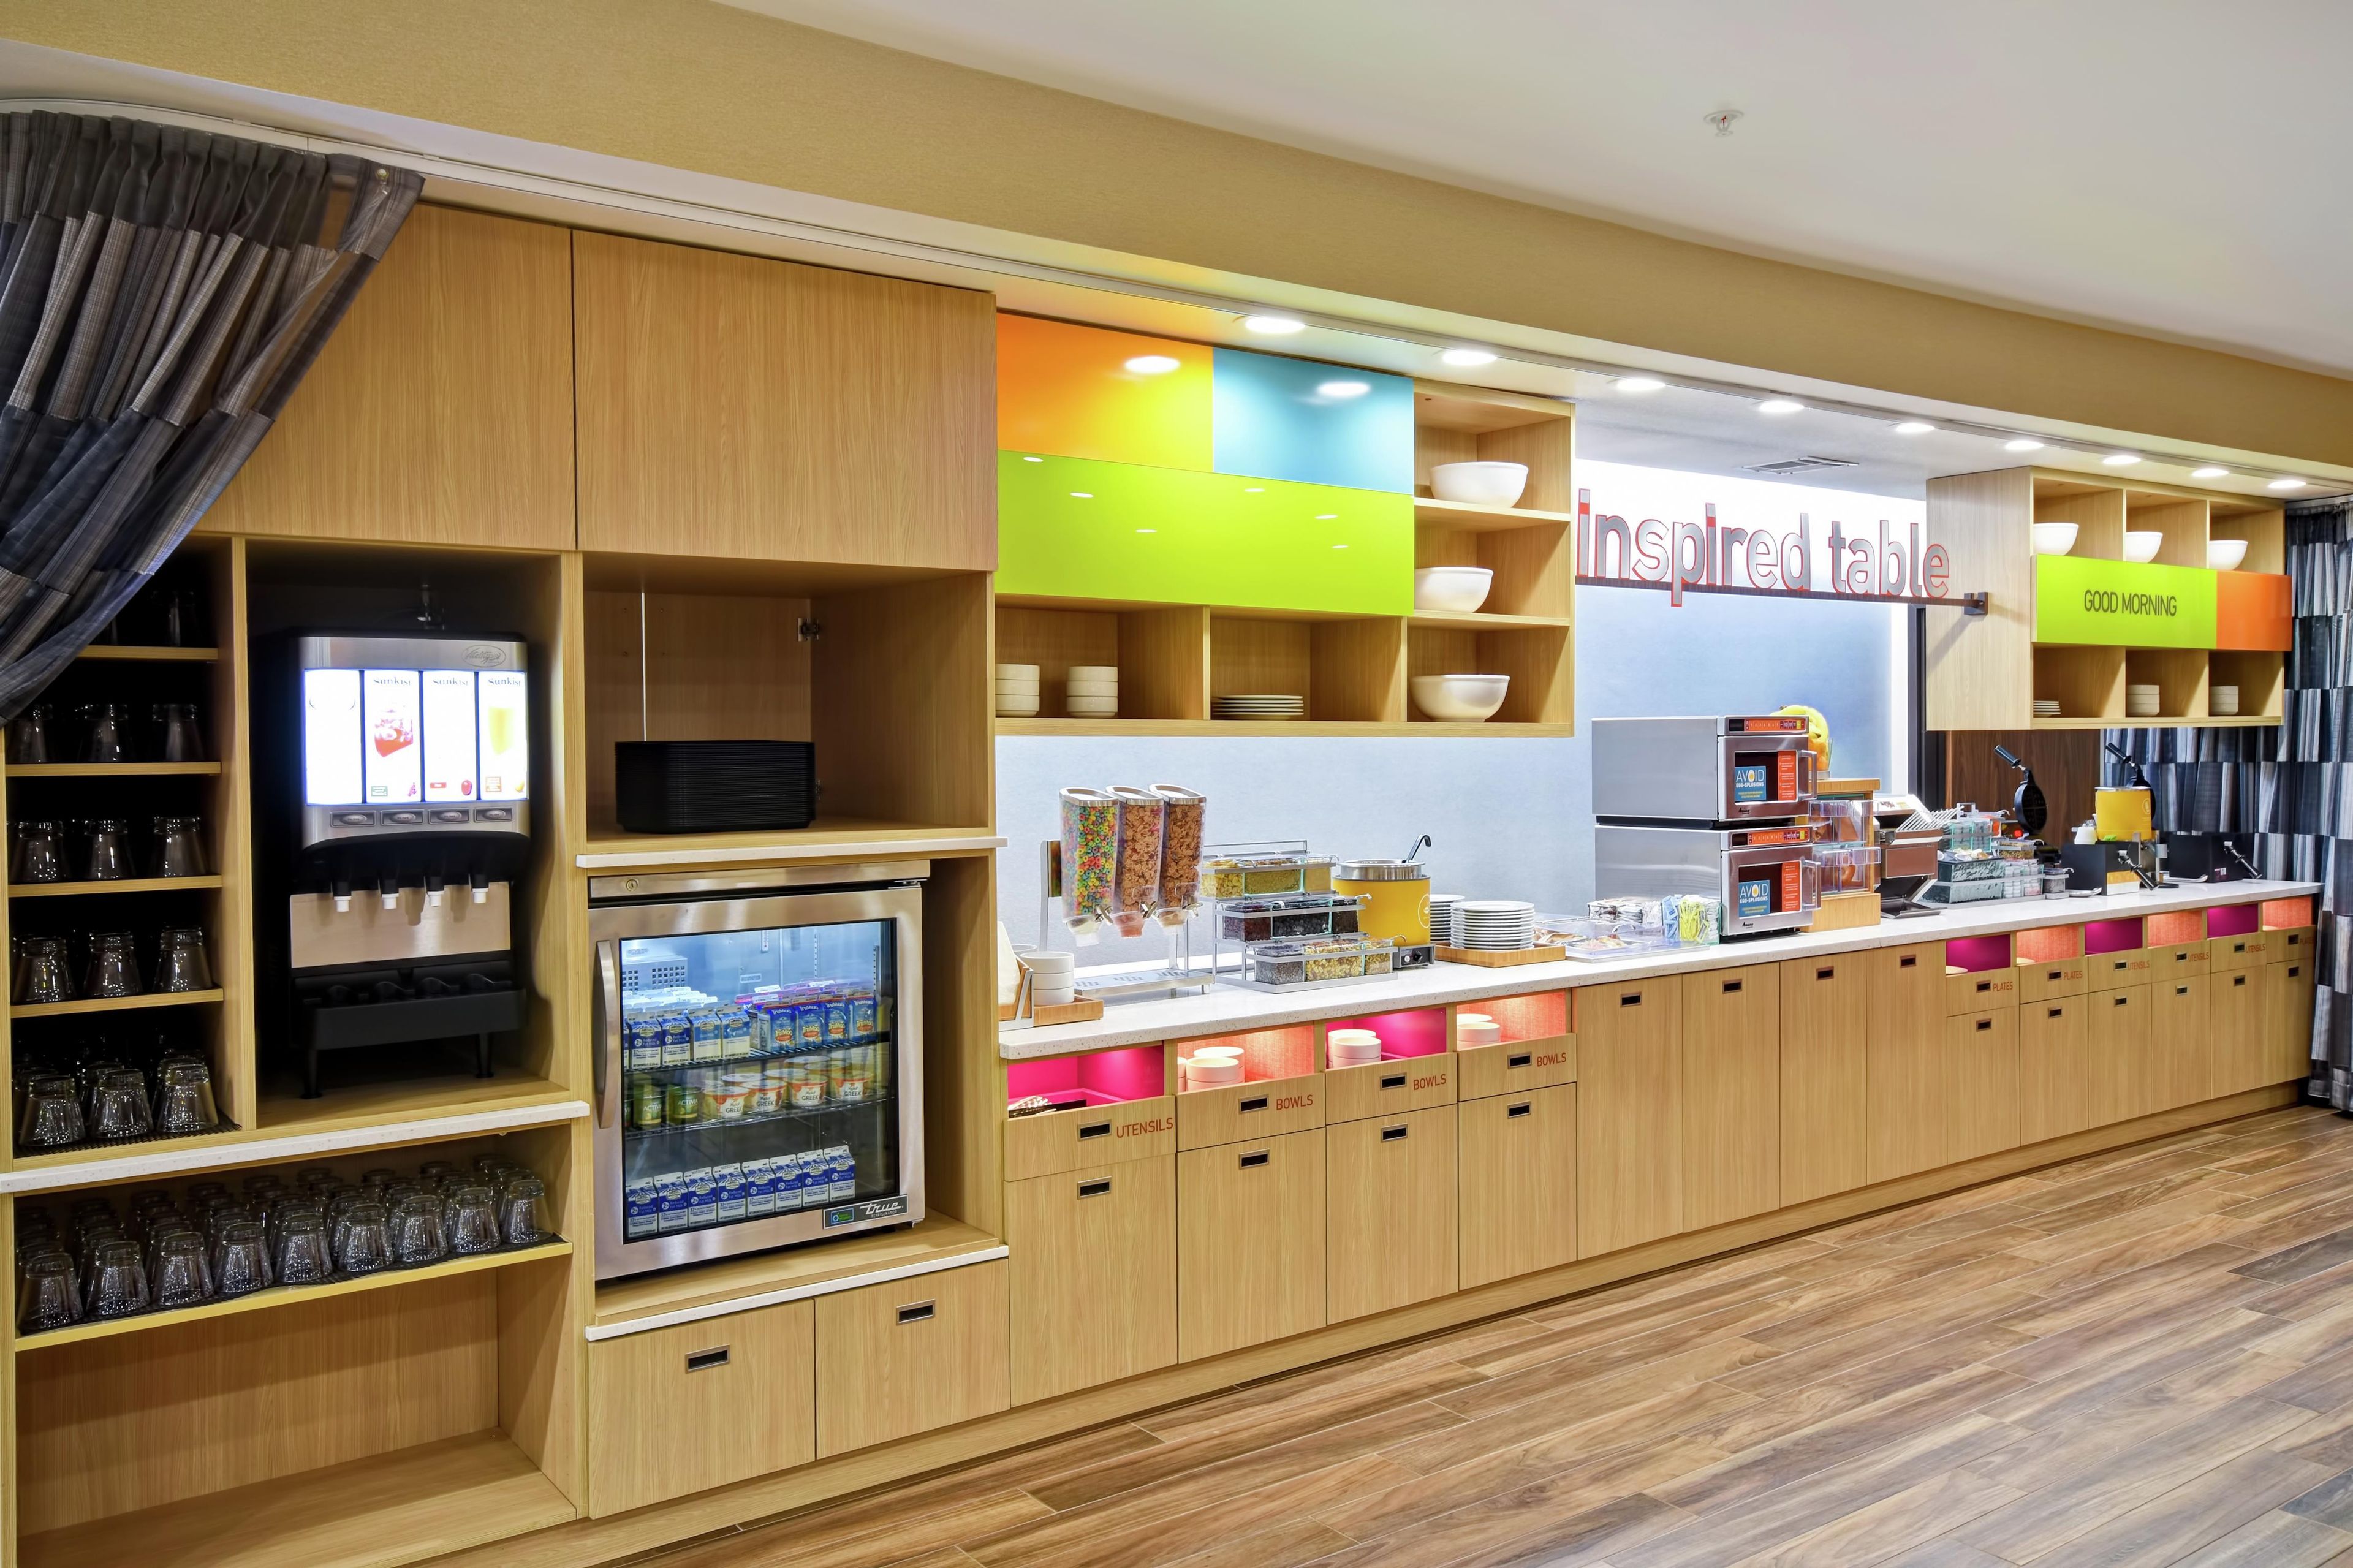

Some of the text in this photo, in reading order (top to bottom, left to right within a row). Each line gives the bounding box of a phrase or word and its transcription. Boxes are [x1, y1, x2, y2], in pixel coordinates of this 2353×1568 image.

[1576, 488, 1950, 607] inspired table
[2084, 589, 2177, 617] GOOD MORNING
[1736, 769, 1765, 782] AVOID
[1740, 884, 1768, 898] AVOID
[2188, 952, 2210, 962] UTENSILS
[2128, 960, 2150, 971] UTENSILS
[2064, 971, 2083, 980] PLATES
[1993, 982, 2014, 991] PLATES
[1537, 1053, 1567, 1067] BOWLS
[1413, 1074, 1447, 1090] BOWLS
[1276, 1095, 1314, 1111] BOWLS
[1116, 1118, 1173, 1138] UTENSILS
